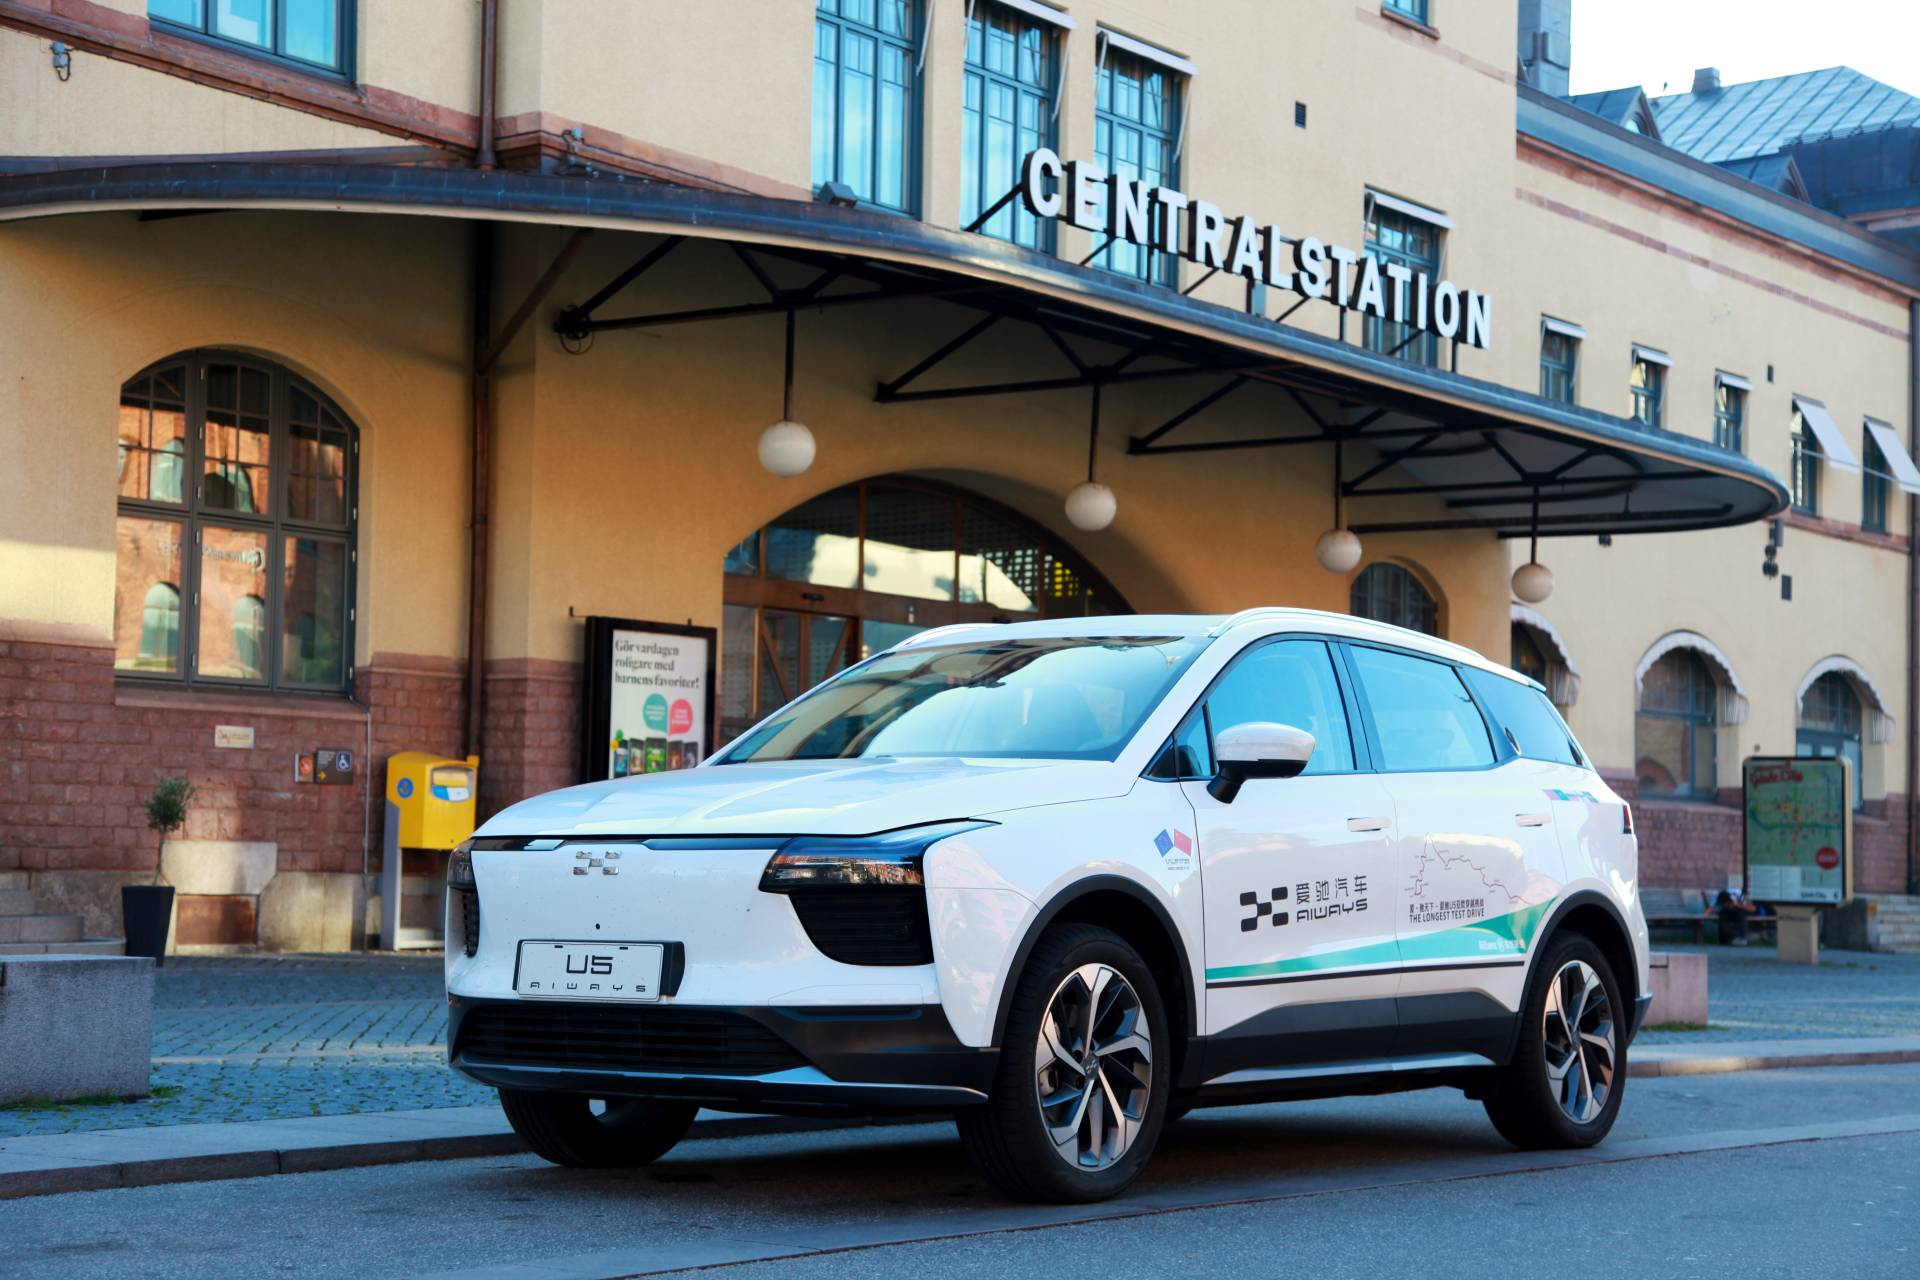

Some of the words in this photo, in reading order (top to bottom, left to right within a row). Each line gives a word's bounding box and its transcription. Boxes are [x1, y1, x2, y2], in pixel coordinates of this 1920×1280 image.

[1022, 147, 1492, 349] CENTRALSTATION
[615, 640, 634, 652] Gör
[634, 643, 679, 658] vardagen
[615, 656, 652, 672] roligare
[654, 660, 675, 671] med
[615, 672, 653, 685] barnens
[655, 674, 699, 688] favoriter!
[1296, 874, 1367, 905] 爱驰汽车
[1296, 898, 1368, 923] AIWAYS
[1409, 913, 1423, 924] THE
[1423, 911, 1450, 923] LONGEST
[1451, 909, 1466, 920] TEST
[1467, 908, 1485, 918] DRIVE
[566, 954, 613, 975] U5
[530, 981, 646, 993] AIWAYS
